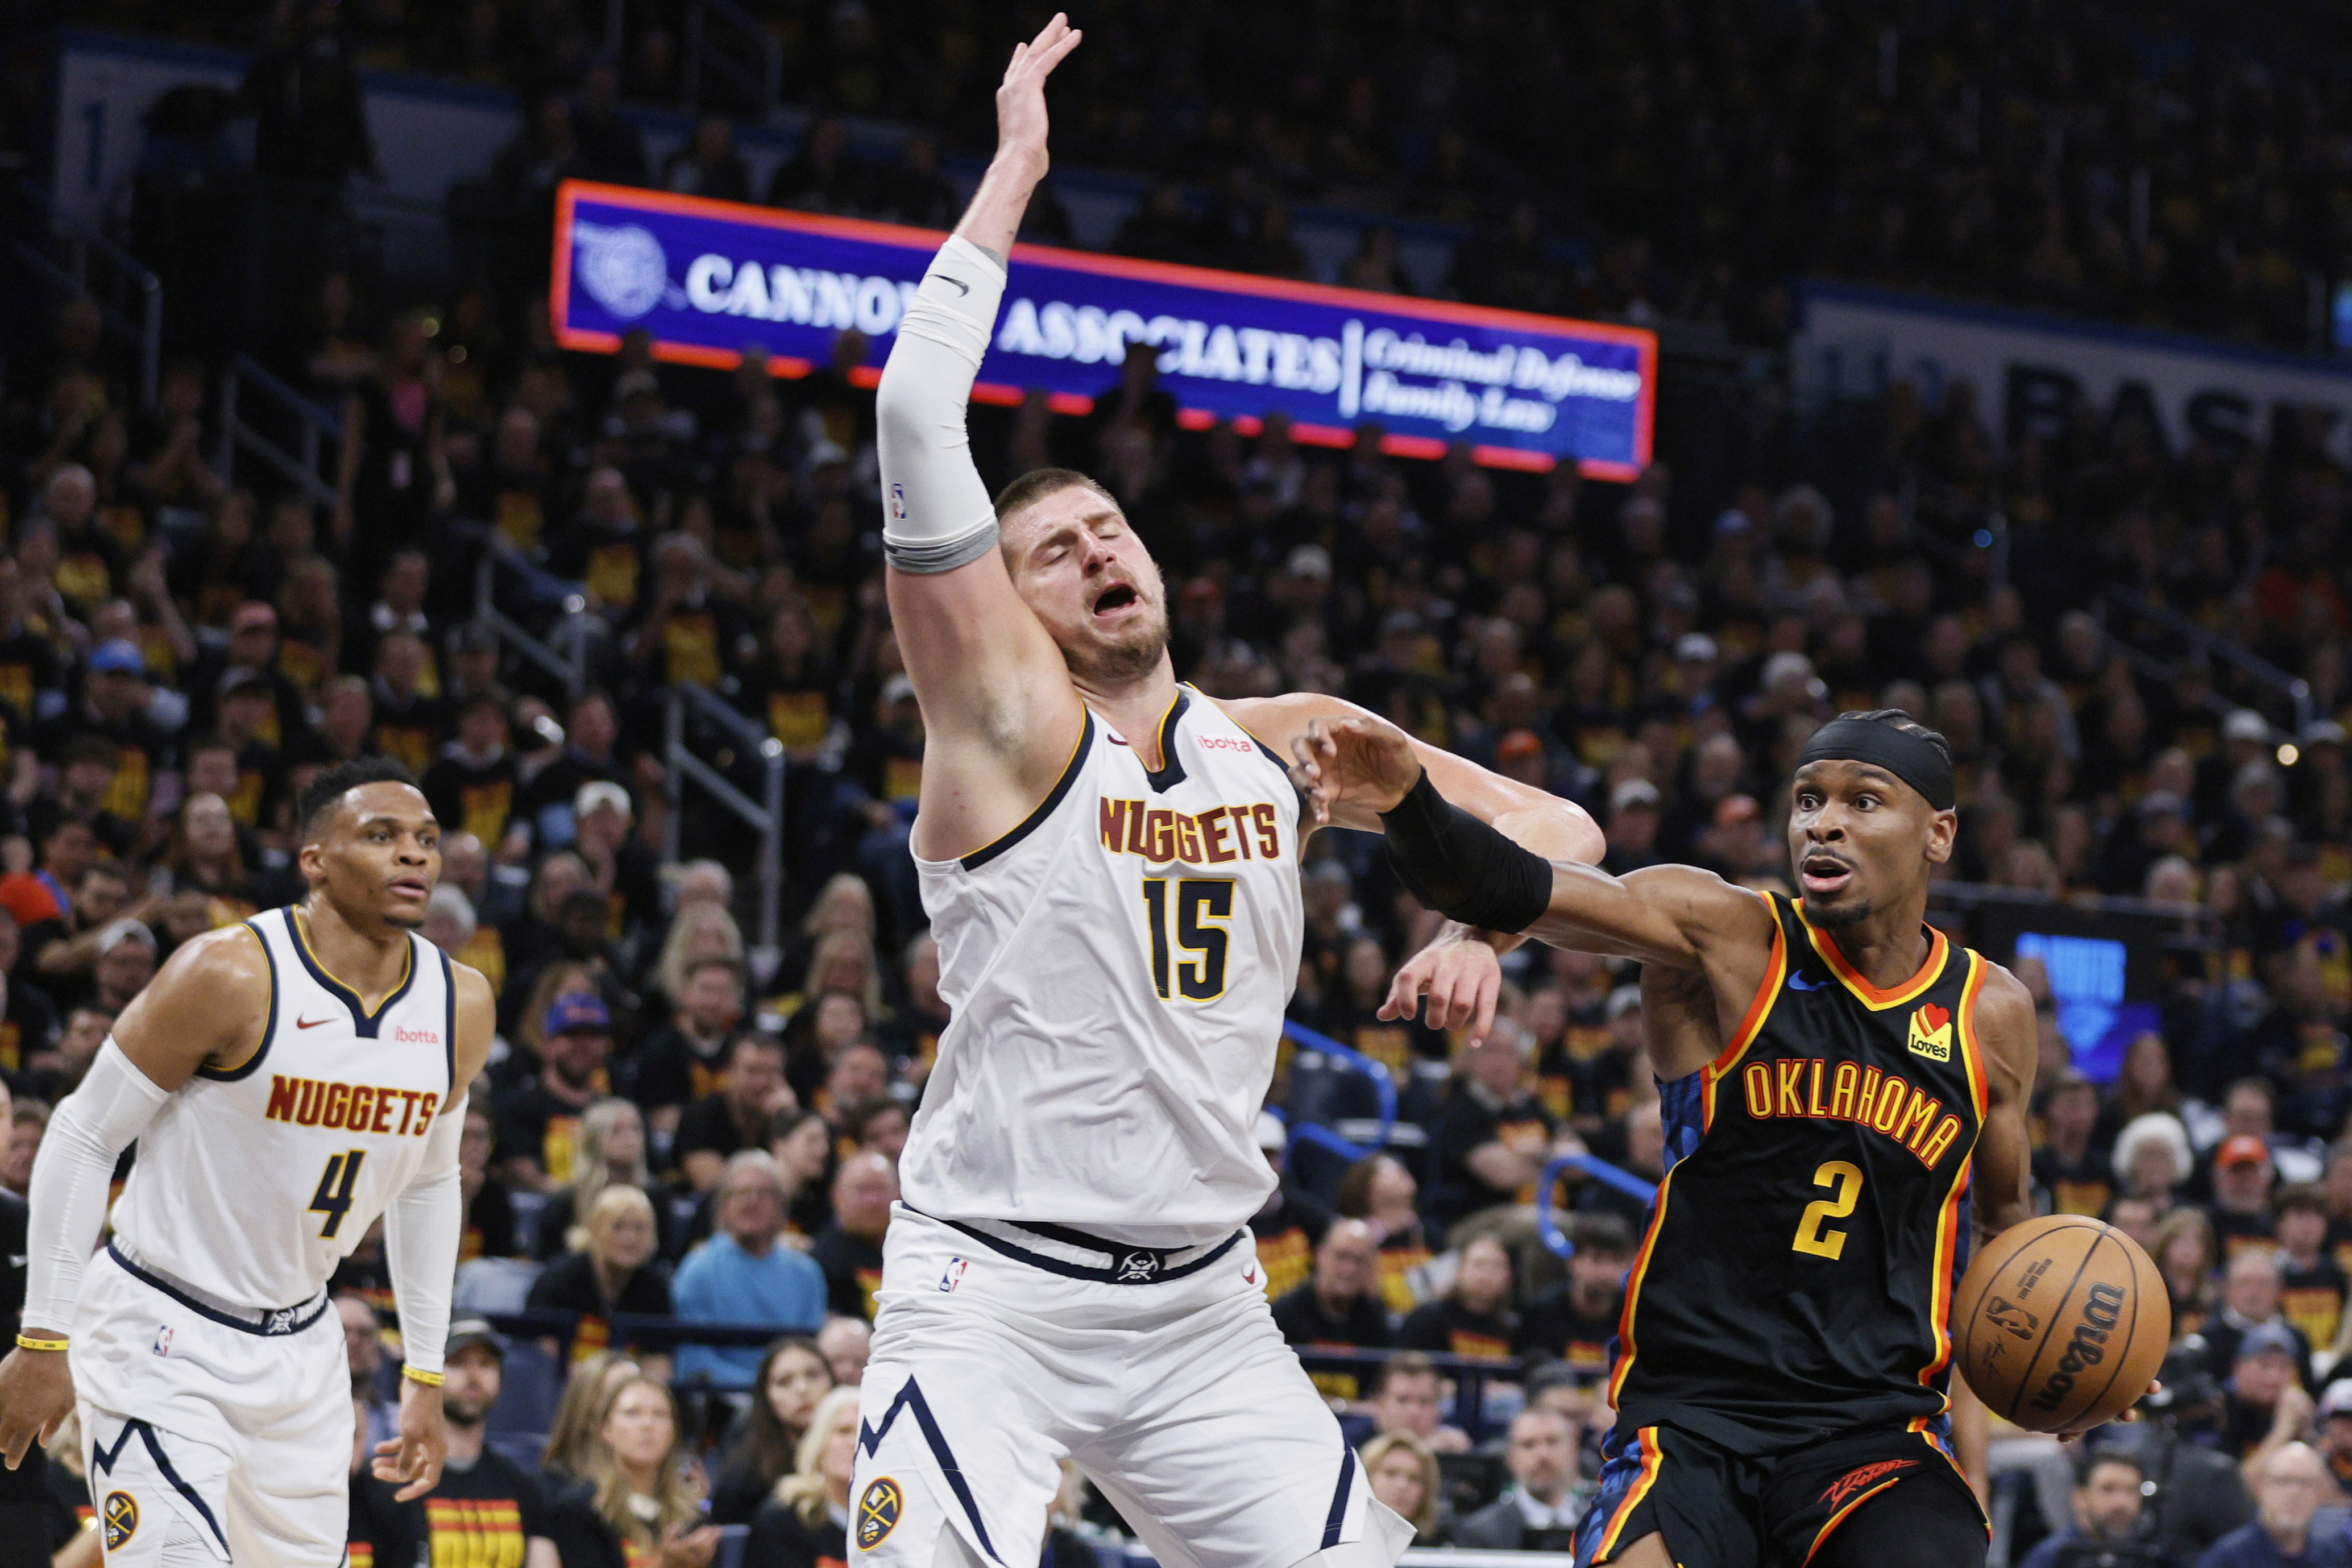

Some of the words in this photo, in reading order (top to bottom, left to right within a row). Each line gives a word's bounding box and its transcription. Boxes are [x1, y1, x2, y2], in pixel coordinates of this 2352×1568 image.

[686, 253, 920, 338] CANNO
[1362, 370, 1479, 432] Family
[1478, 385, 1557, 434] Law
[1364, 327, 1517, 386] Criminal
[1512, 347, 1641, 402] Defense
[1196, 735, 1252, 752] ibotta
[1100, 797, 1280, 864] NUGGETS
[1142, 878, 1236, 1002] 15
[395, 1026, 439, 1044] ibotta
[265, 1074, 439, 1137] NUGGETS
[1743, 1059, 1962, 1171] OKLAHOMA
[306, 1149, 367, 1239] 4
[1792, 1160, 1864, 1260] 2
[2030, 1281, 2126, 1412] Wilson
